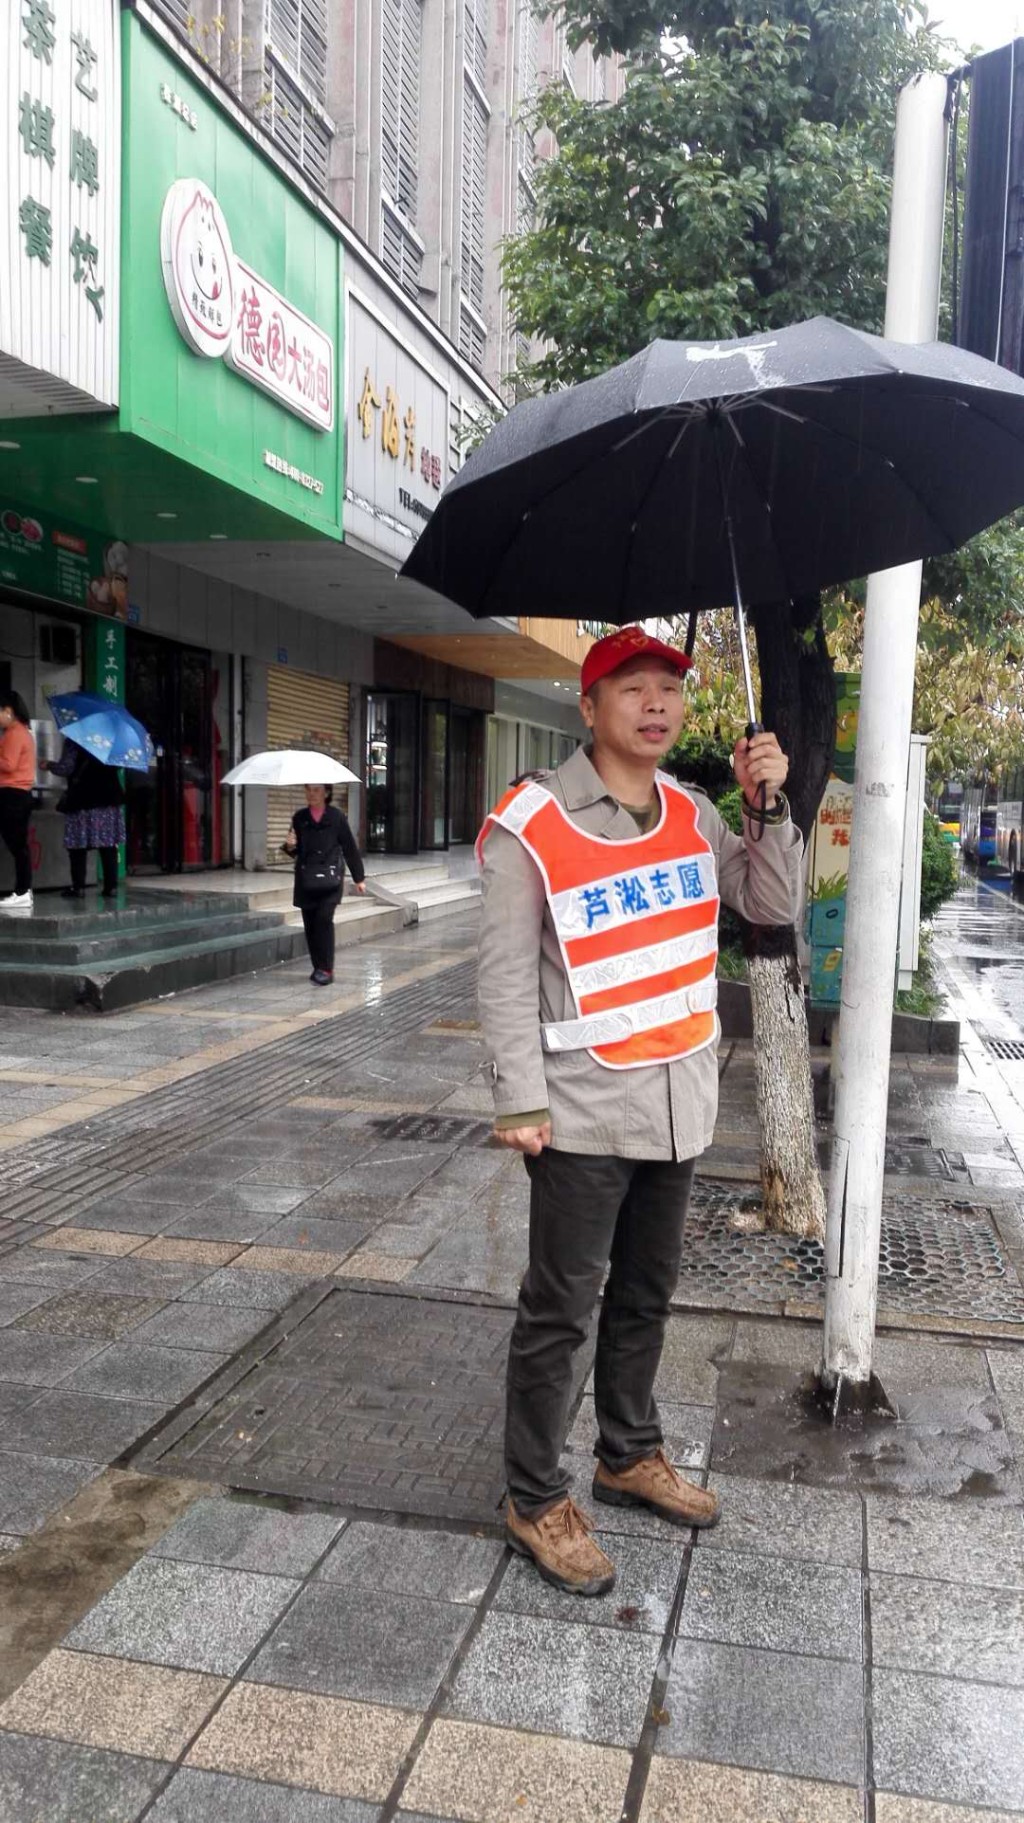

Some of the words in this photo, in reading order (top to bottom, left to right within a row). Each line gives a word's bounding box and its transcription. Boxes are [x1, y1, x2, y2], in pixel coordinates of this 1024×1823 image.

[19, 91, 99, 197] 棋牌
[103, 629, 119, 704] 手工制
[578, 862, 704, 929] 芦淞志愿
